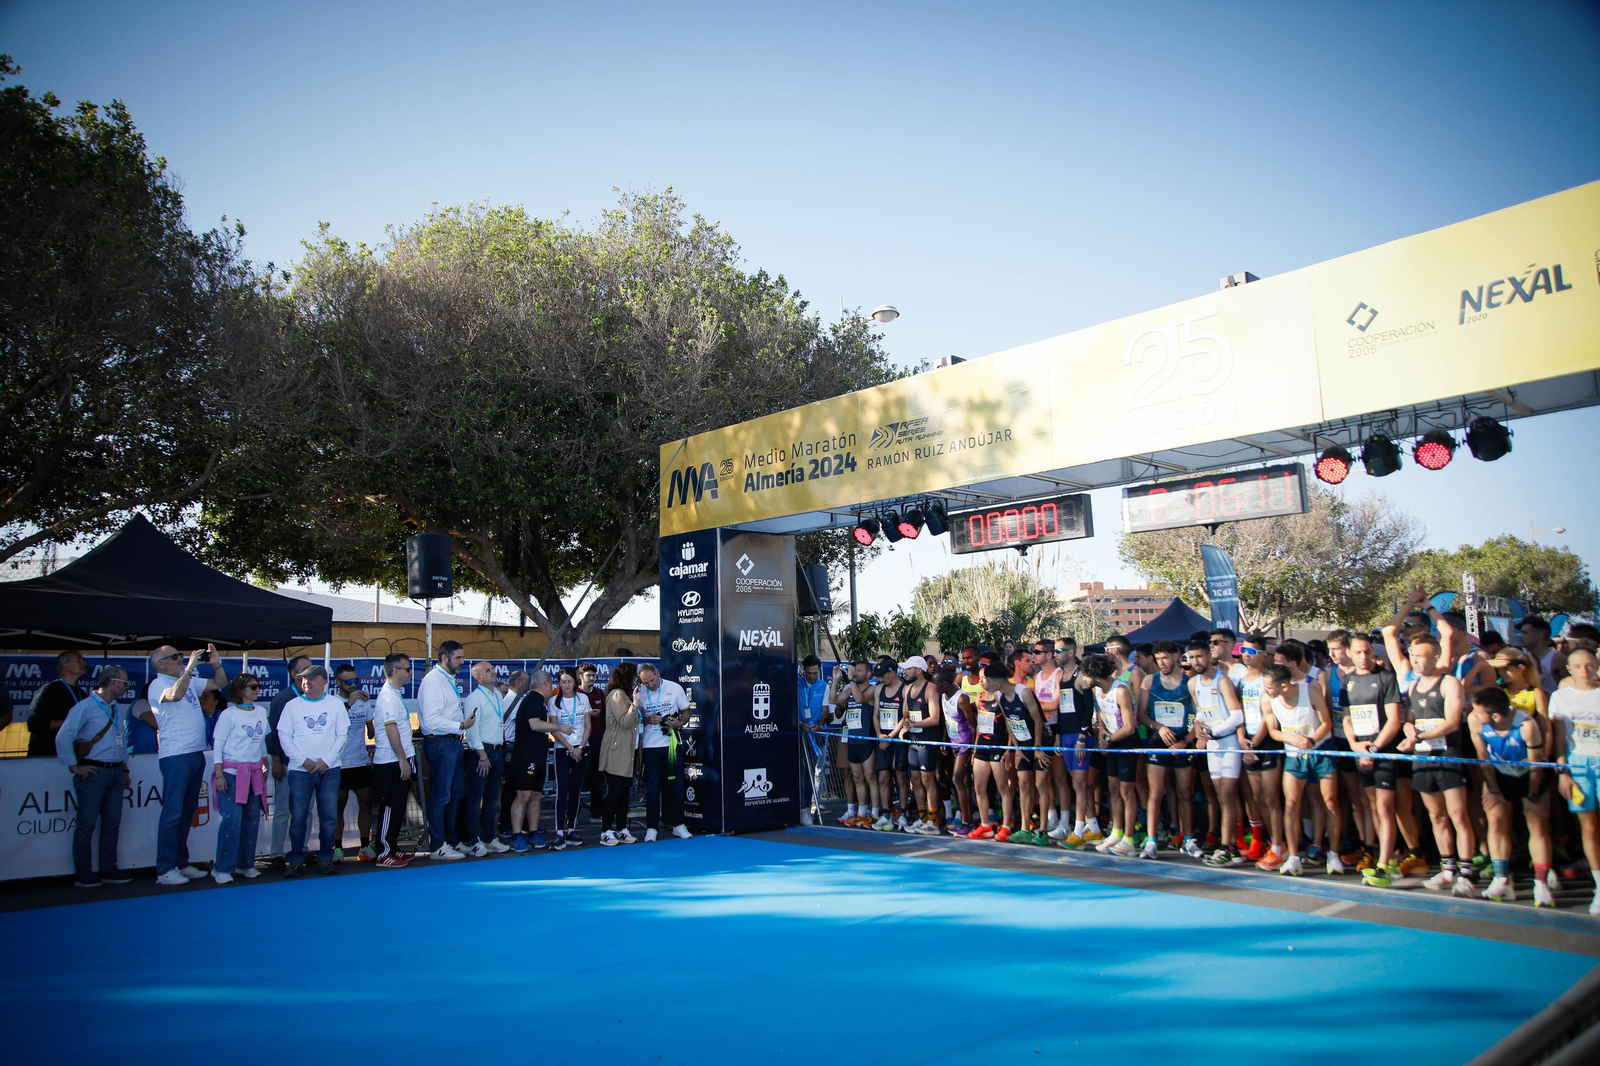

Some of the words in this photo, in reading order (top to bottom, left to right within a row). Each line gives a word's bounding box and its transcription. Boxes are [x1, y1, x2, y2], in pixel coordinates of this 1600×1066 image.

[1458, 263, 1573, 326] NEXAL
[1466, 312, 1488, 324] 2020
[1347, 320, 1436, 348] COOPERACIÓN
[1348, 344, 1378, 359] 2005
[895, 436, 913, 445] RUTA
[914, 430, 944, 441] RUNNING
[897, 426, 926, 438] SERIES
[744, 448, 786, 469] Medio
[791, 432, 857, 459] Maratón
[867, 449, 910, 470] RAMÓN
[914, 444, 944, 460] RUIZ
[949, 428, 1012, 453] ANDÚJAR
[719, 458, 734, 476] 25
[743, 463, 805, 493] Almería
[808, 452, 858, 480] 2024
[668, 561, 709, 580] cajamar
[735, 577, 783, 587] COOPERACIÓN
[735, 585, 752, 593] 2005
[677, 607, 704, 617] HYUNDAI
[738, 626, 784, 651] NEXAL
[678, 674, 701, 683] vellsam
[882, 712, 892, 720] 19
[1163, 706, 1176, 714] 12
[1203, 710, 1213, 718] 11
[1351, 710, 1373, 720] 1507
[744, 722, 779, 734] ALMERÍA
